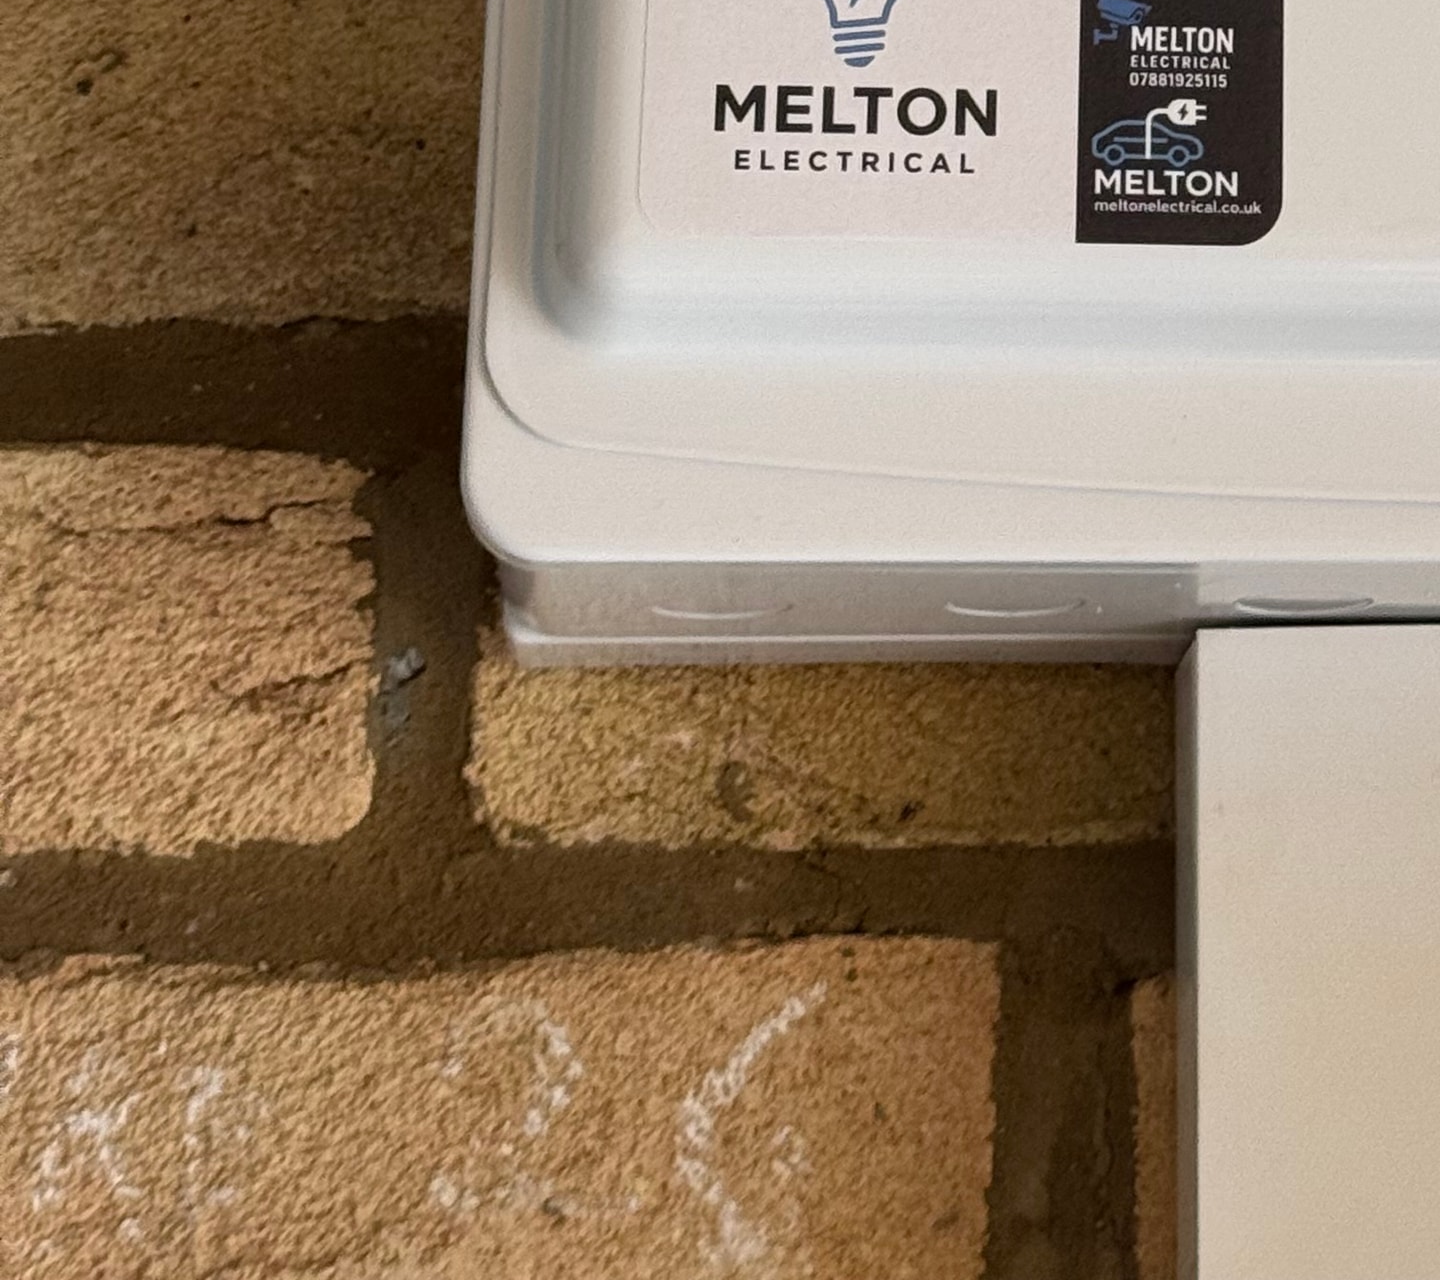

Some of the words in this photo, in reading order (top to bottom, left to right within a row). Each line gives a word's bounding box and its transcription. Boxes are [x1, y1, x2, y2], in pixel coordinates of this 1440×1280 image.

[1131, 25, 1234, 53] MELTON
[1130, 55, 1231, 69] ELECTRICAL
[1129, 72, 1228, 88] 07881925115
[713, 83, 998, 138] MELTON
[734, 149, 976, 174] ELECTRICAL
[1094, 169, 1238, 197] MELTON
[1094, 199, 1262, 214] meltonelectrical.co.uk
